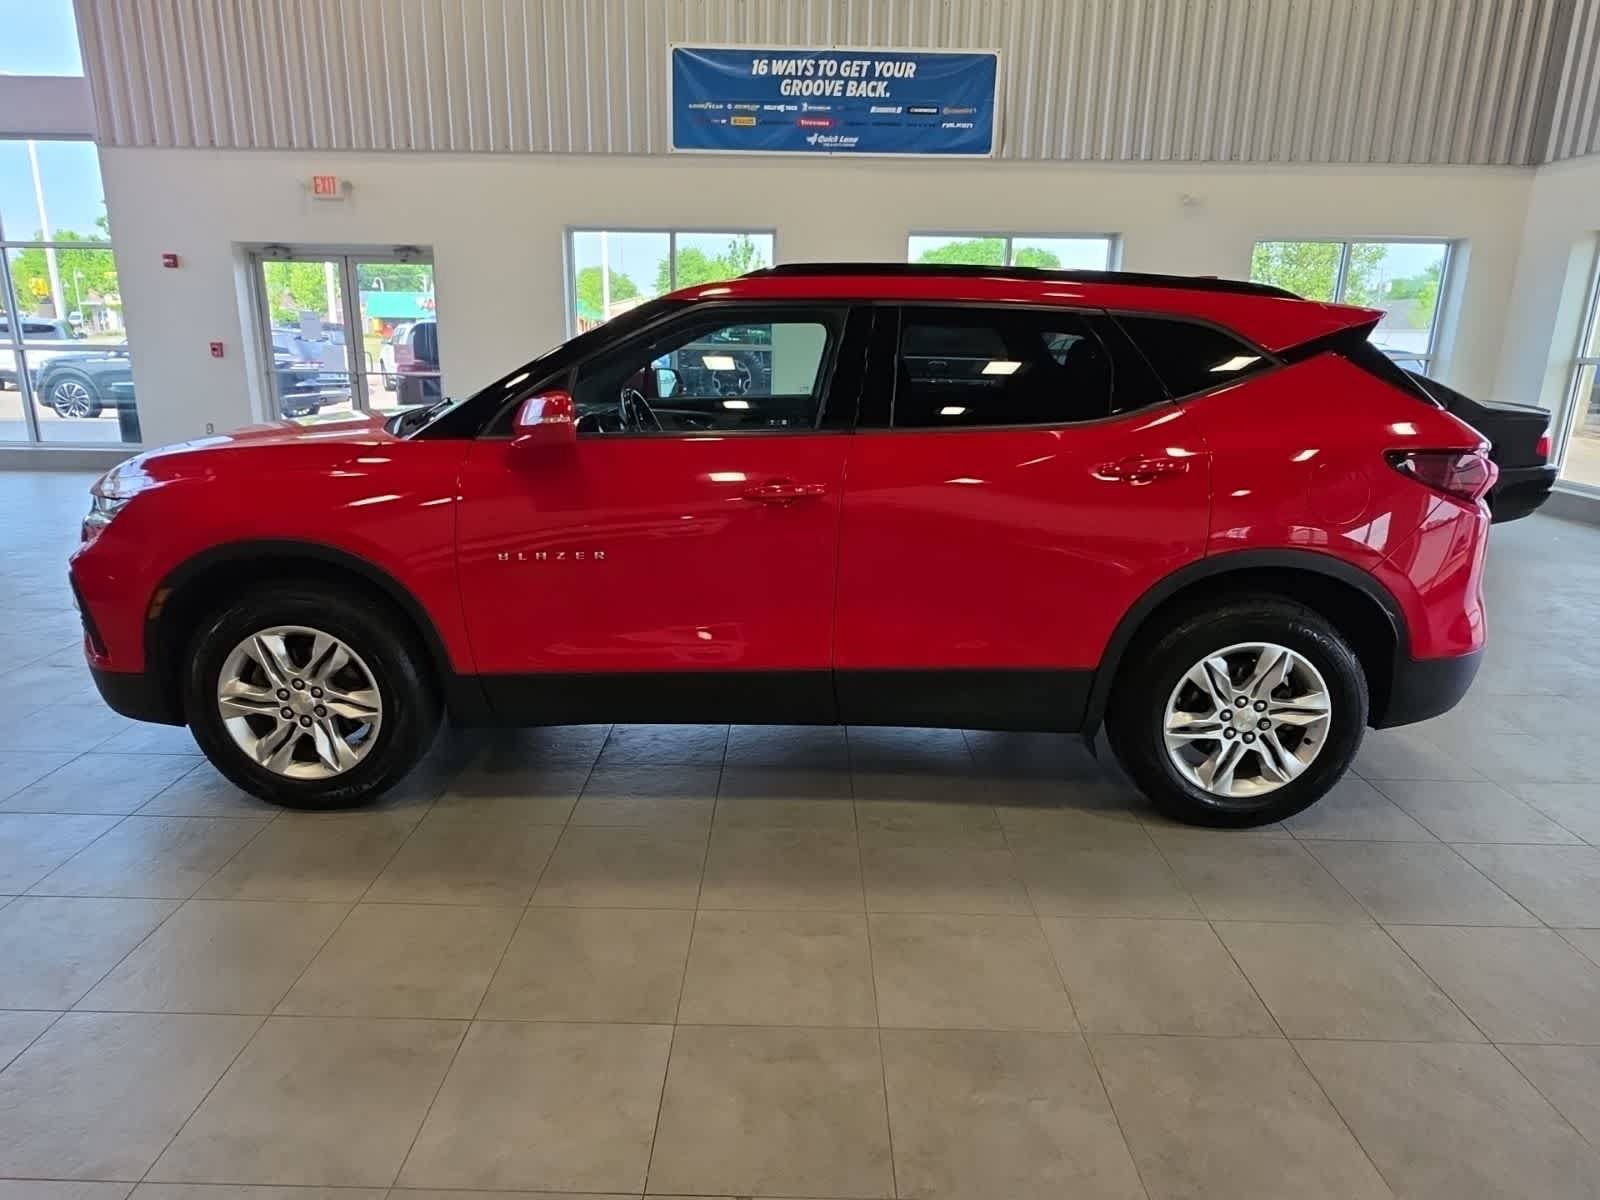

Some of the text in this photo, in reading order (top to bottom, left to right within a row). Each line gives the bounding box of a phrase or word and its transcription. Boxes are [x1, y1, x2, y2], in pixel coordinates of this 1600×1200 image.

[752, 60, 917, 78] 16 WAYS TO GET YOUR
[780, 79, 891, 98] GROOVE BACK.
[313, 175, 336, 195] EXIT
[497, 551, 606, 561] BLAZER
